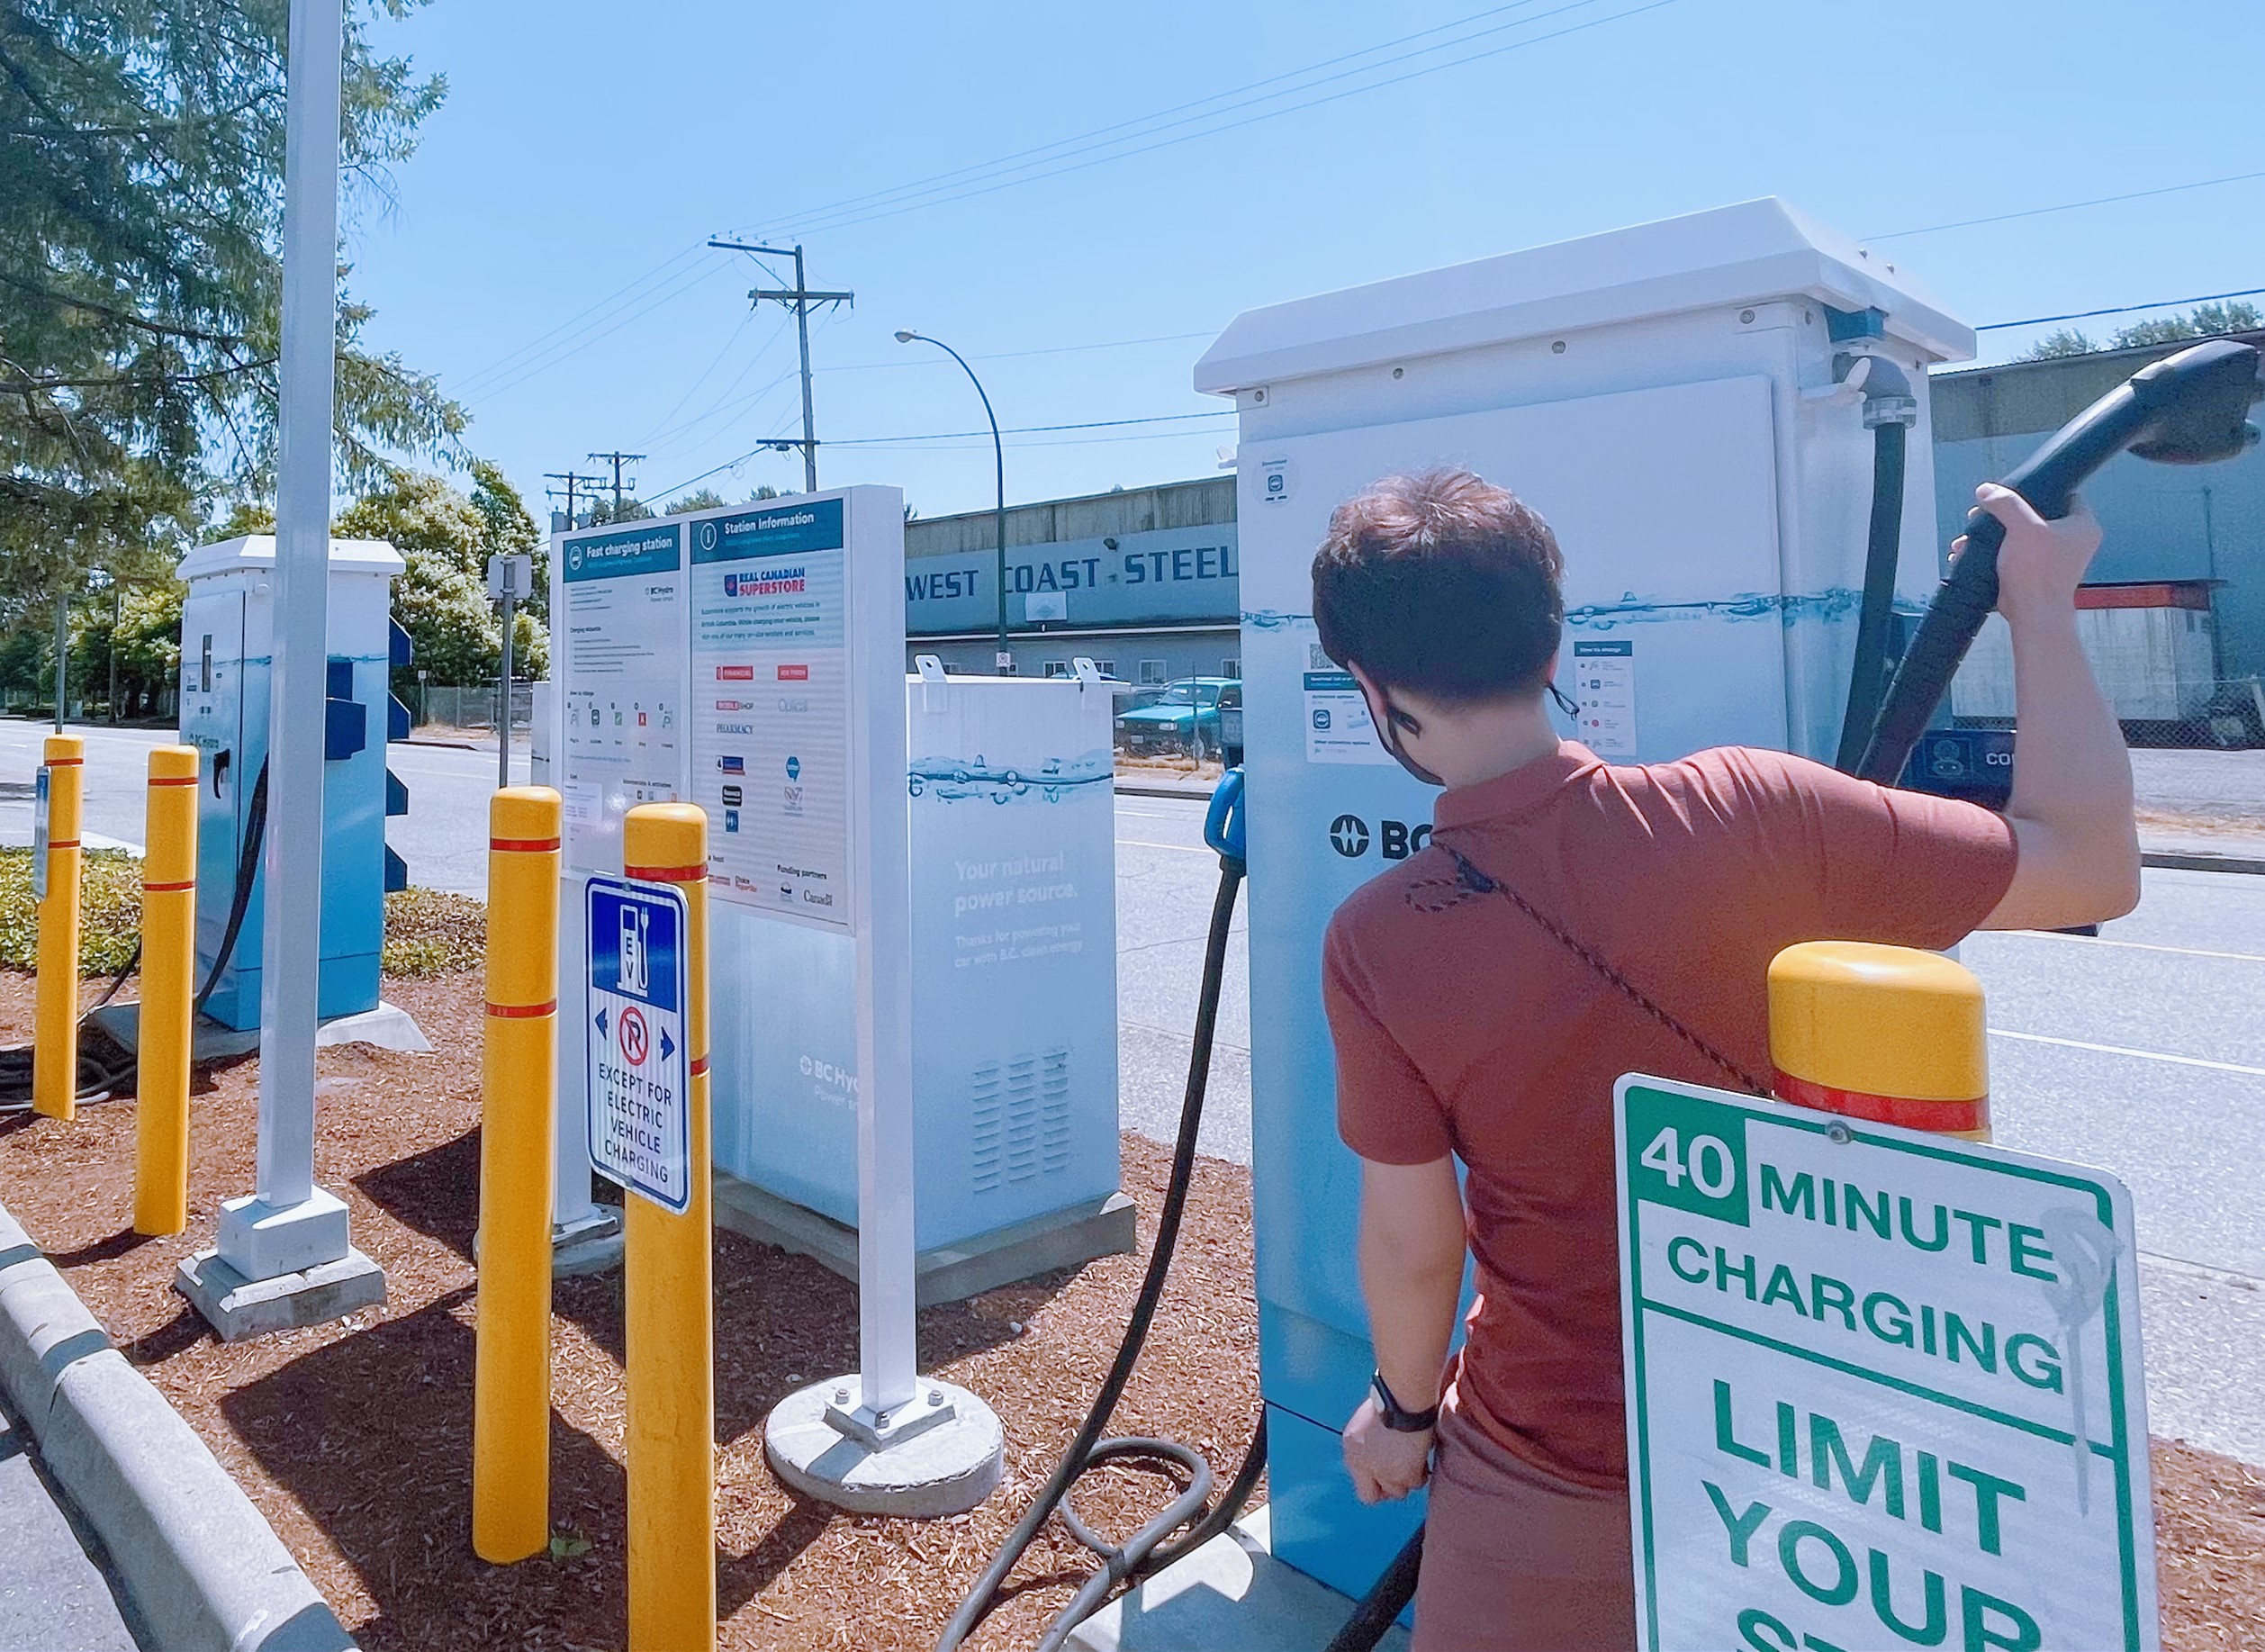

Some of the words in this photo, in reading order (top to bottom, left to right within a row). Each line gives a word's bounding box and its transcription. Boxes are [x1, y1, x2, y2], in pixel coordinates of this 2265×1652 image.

[725, 519, 756, 535] Station
[587, 546, 603, 558] Fast
[605, 540, 641, 557] charging
[642, 535, 672, 552] station
[739, 572, 759, 583] REAL
[761, 567, 806, 582] CANADIAN
[739, 579, 806, 597] SUPERSTORE
[906, 569, 979, 602] WEST
[1123, 545, 1240, 585] STEEL
[717, 723, 754, 735] PHARMACY
[1986, 752, 2015, 766] CO
[777, 864, 800, 877] Funding
[801, 871, 827, 880] partners
[954, 858, 998, 881] Your
[1001, 850, 1064, 876] natural
[954, 889, 1014, 918] power
[1017, 882, 1078, 903] source.
[955, 934, 993, 948] Thanks
[599, 1062, 644, 1095] EXCEPT
[647, 1080, 672, 1107] FOR
[607, 1090, 663, 1129] ELECTRIC
[610, 1116, 661, 1155] VEHICLE
[604, 1139, 669, 1184] CHARGING
[1640, 1126, 1736, 1200] 40
[1759, 1163, 2059, 1283] MINUTE
[1666, 1236, 2064, 1395] CHARGING
[1713, 1378, 2026, 1557] LIMIT
